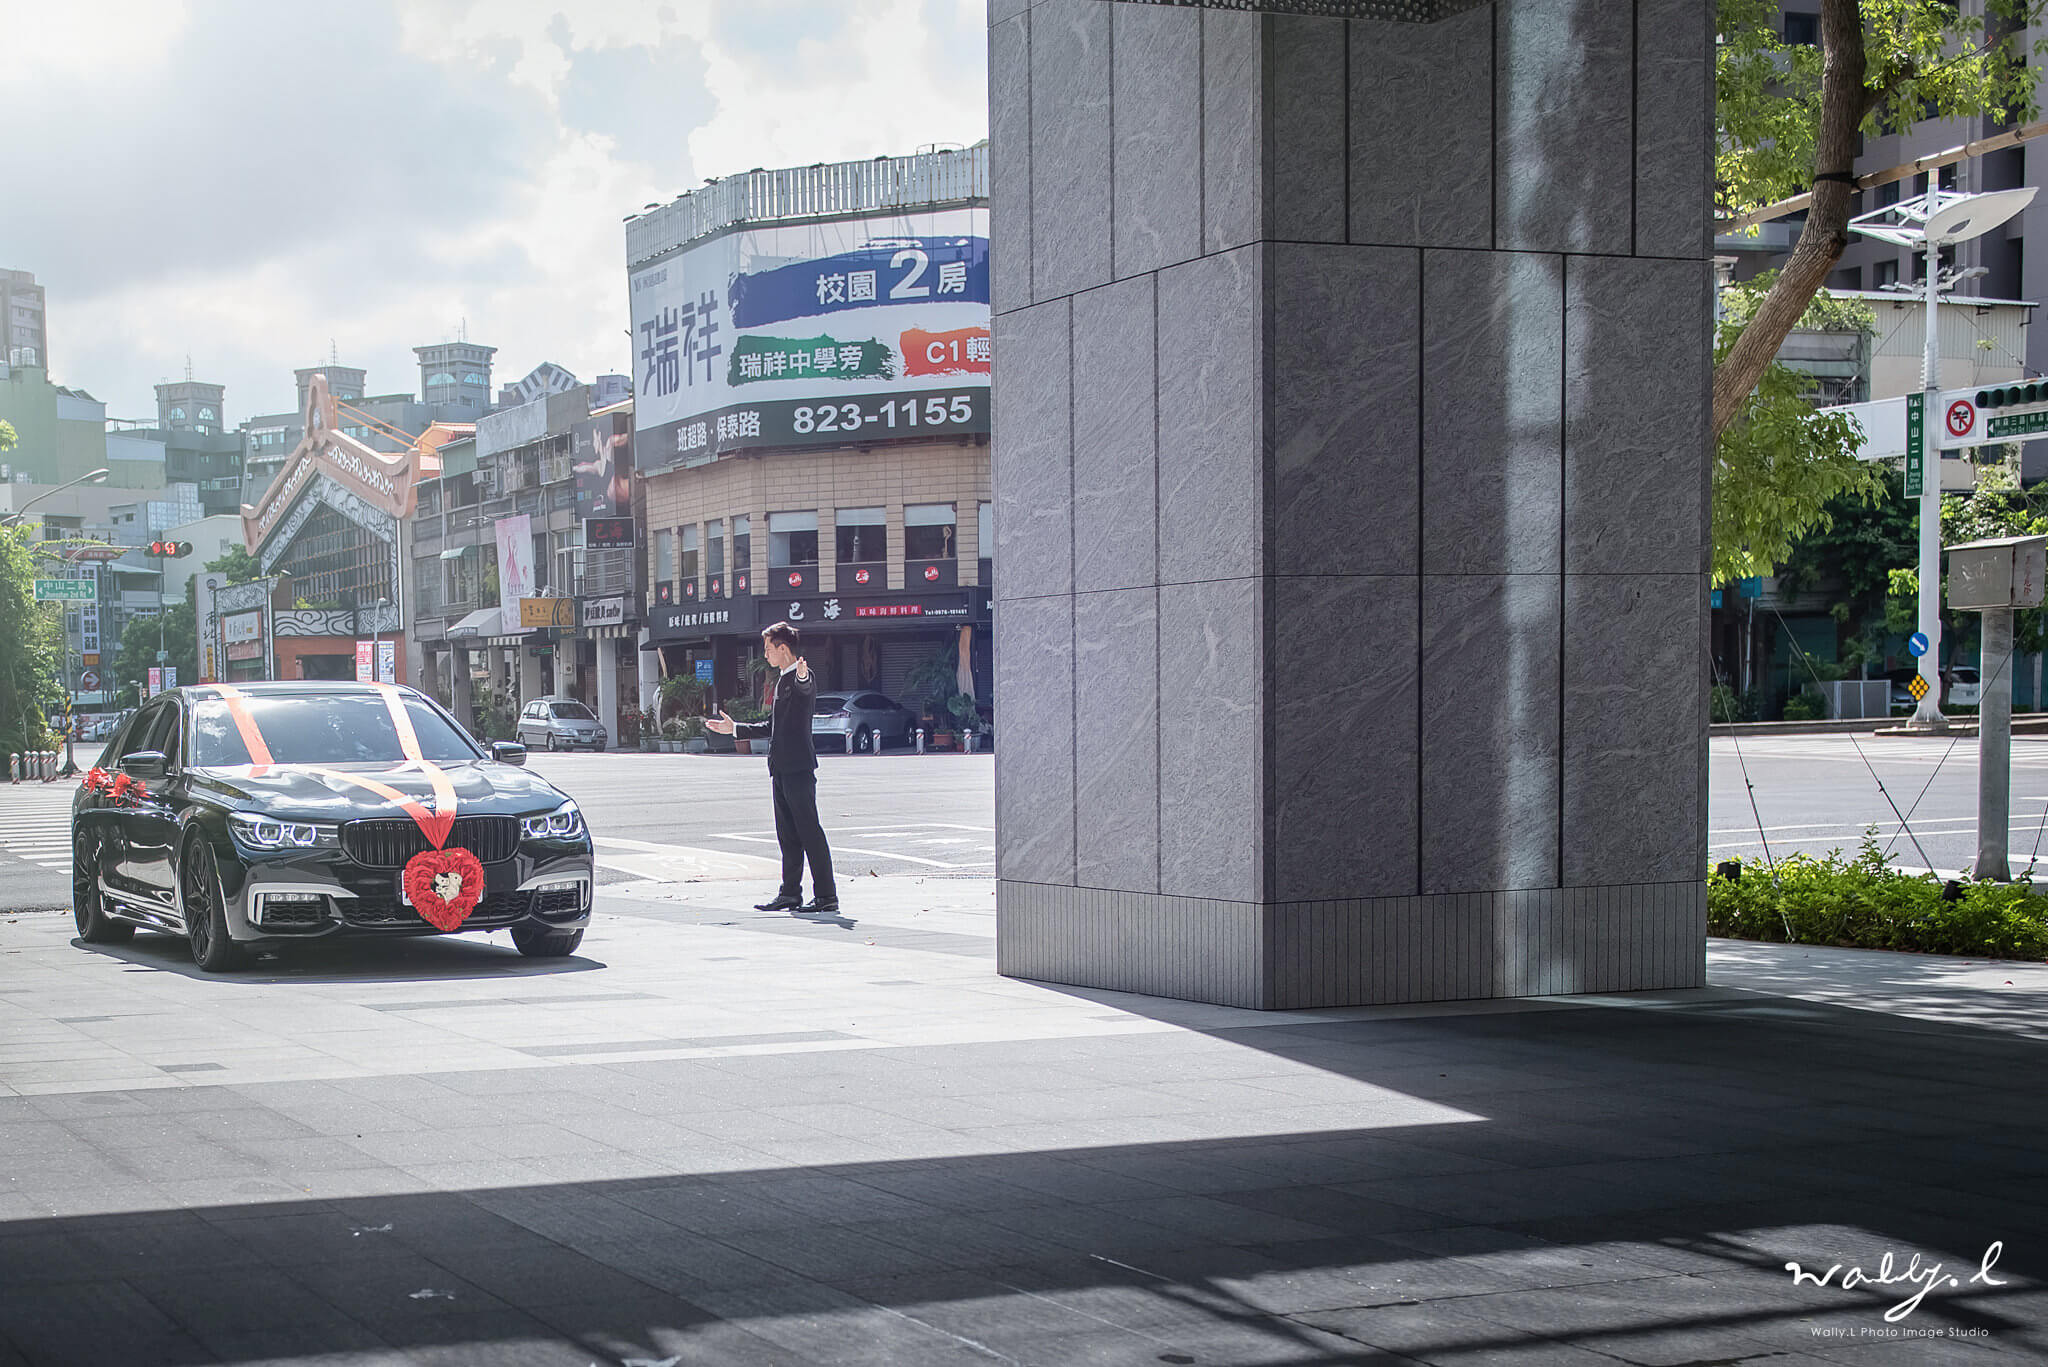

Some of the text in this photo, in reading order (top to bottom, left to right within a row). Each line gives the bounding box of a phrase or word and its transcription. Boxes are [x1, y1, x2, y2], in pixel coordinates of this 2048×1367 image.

[816, 249, 967, 304] 校園2房
[640, 289, 722, 397] 瑞祥
[739, 344, 863, 378] 瑞祥中學旁
[793, 395, 973, 434] 823-1155
[1911, 411, 1919, 470] 中山二路
[43, 581, 87, 591] 中山二路
[789, 598, 842, 620] 巴海
